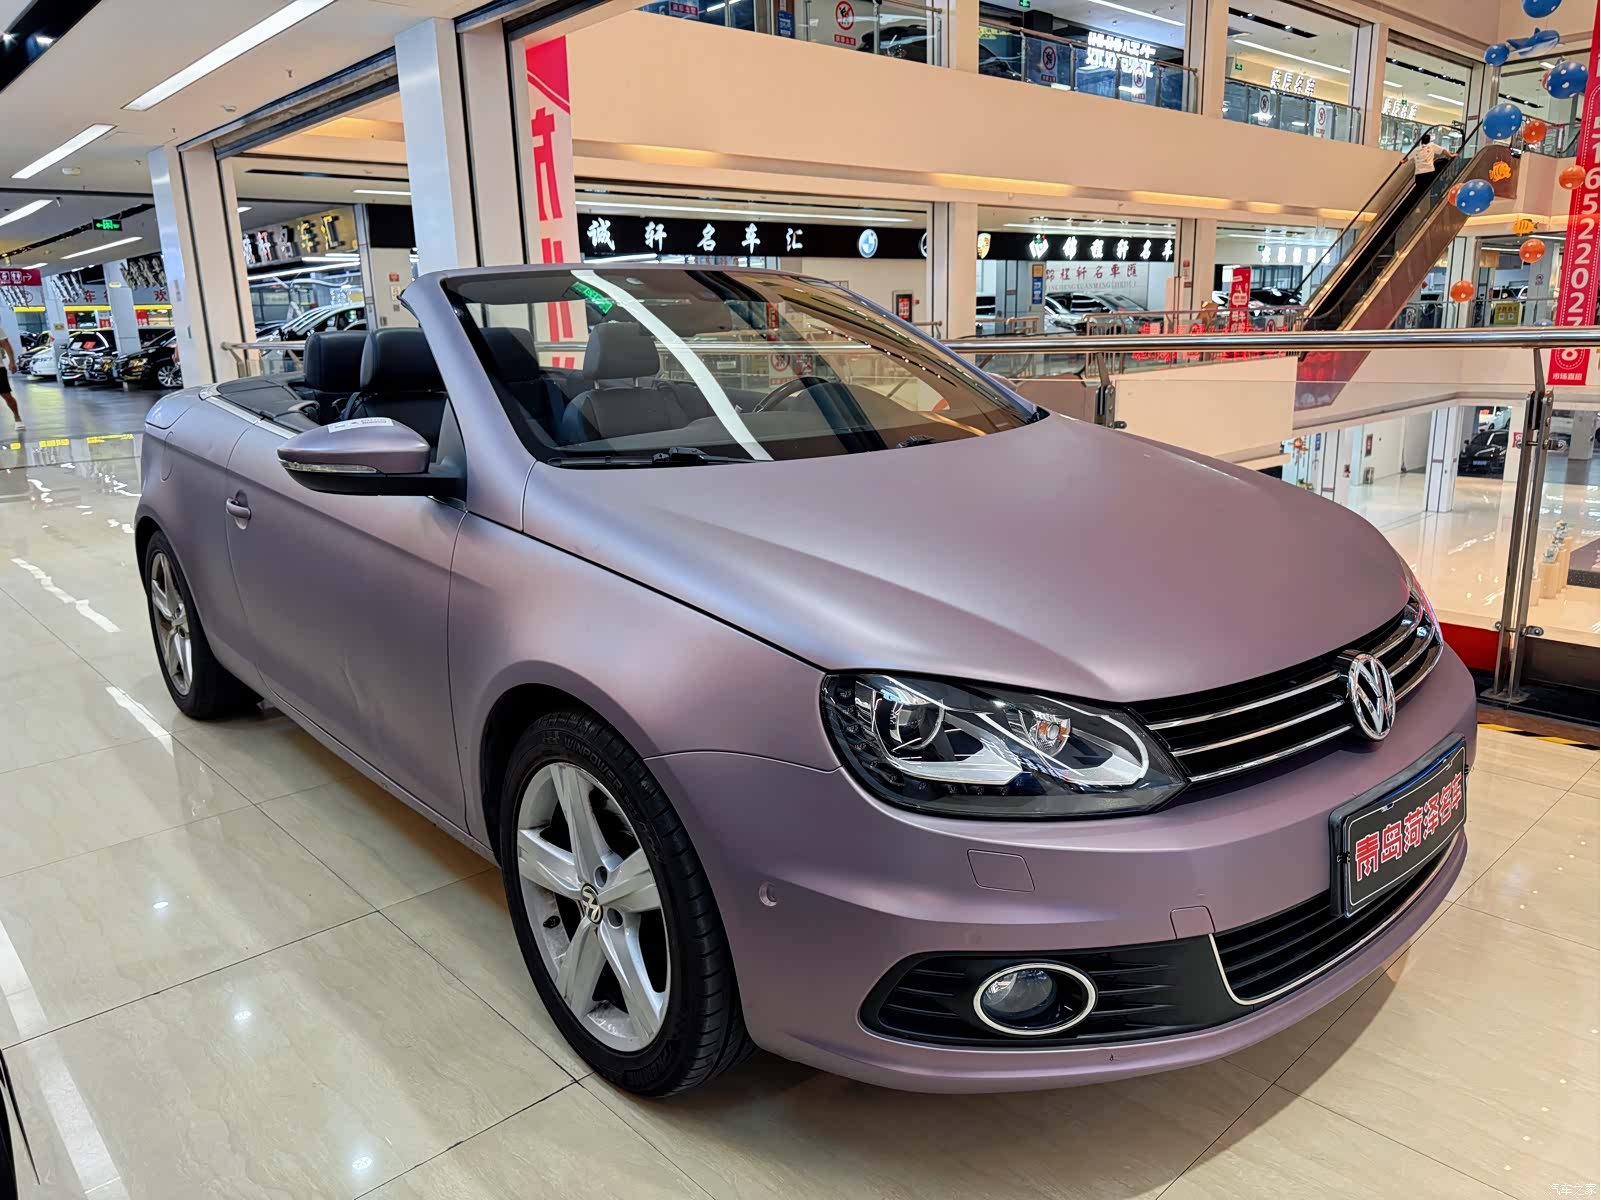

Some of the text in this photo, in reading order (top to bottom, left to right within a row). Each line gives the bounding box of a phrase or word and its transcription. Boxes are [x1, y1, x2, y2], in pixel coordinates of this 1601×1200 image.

[586, 217, 804, 254] 诚轩名车汇
[1355, 771, 1463, 883] 青岛菏泽名车
